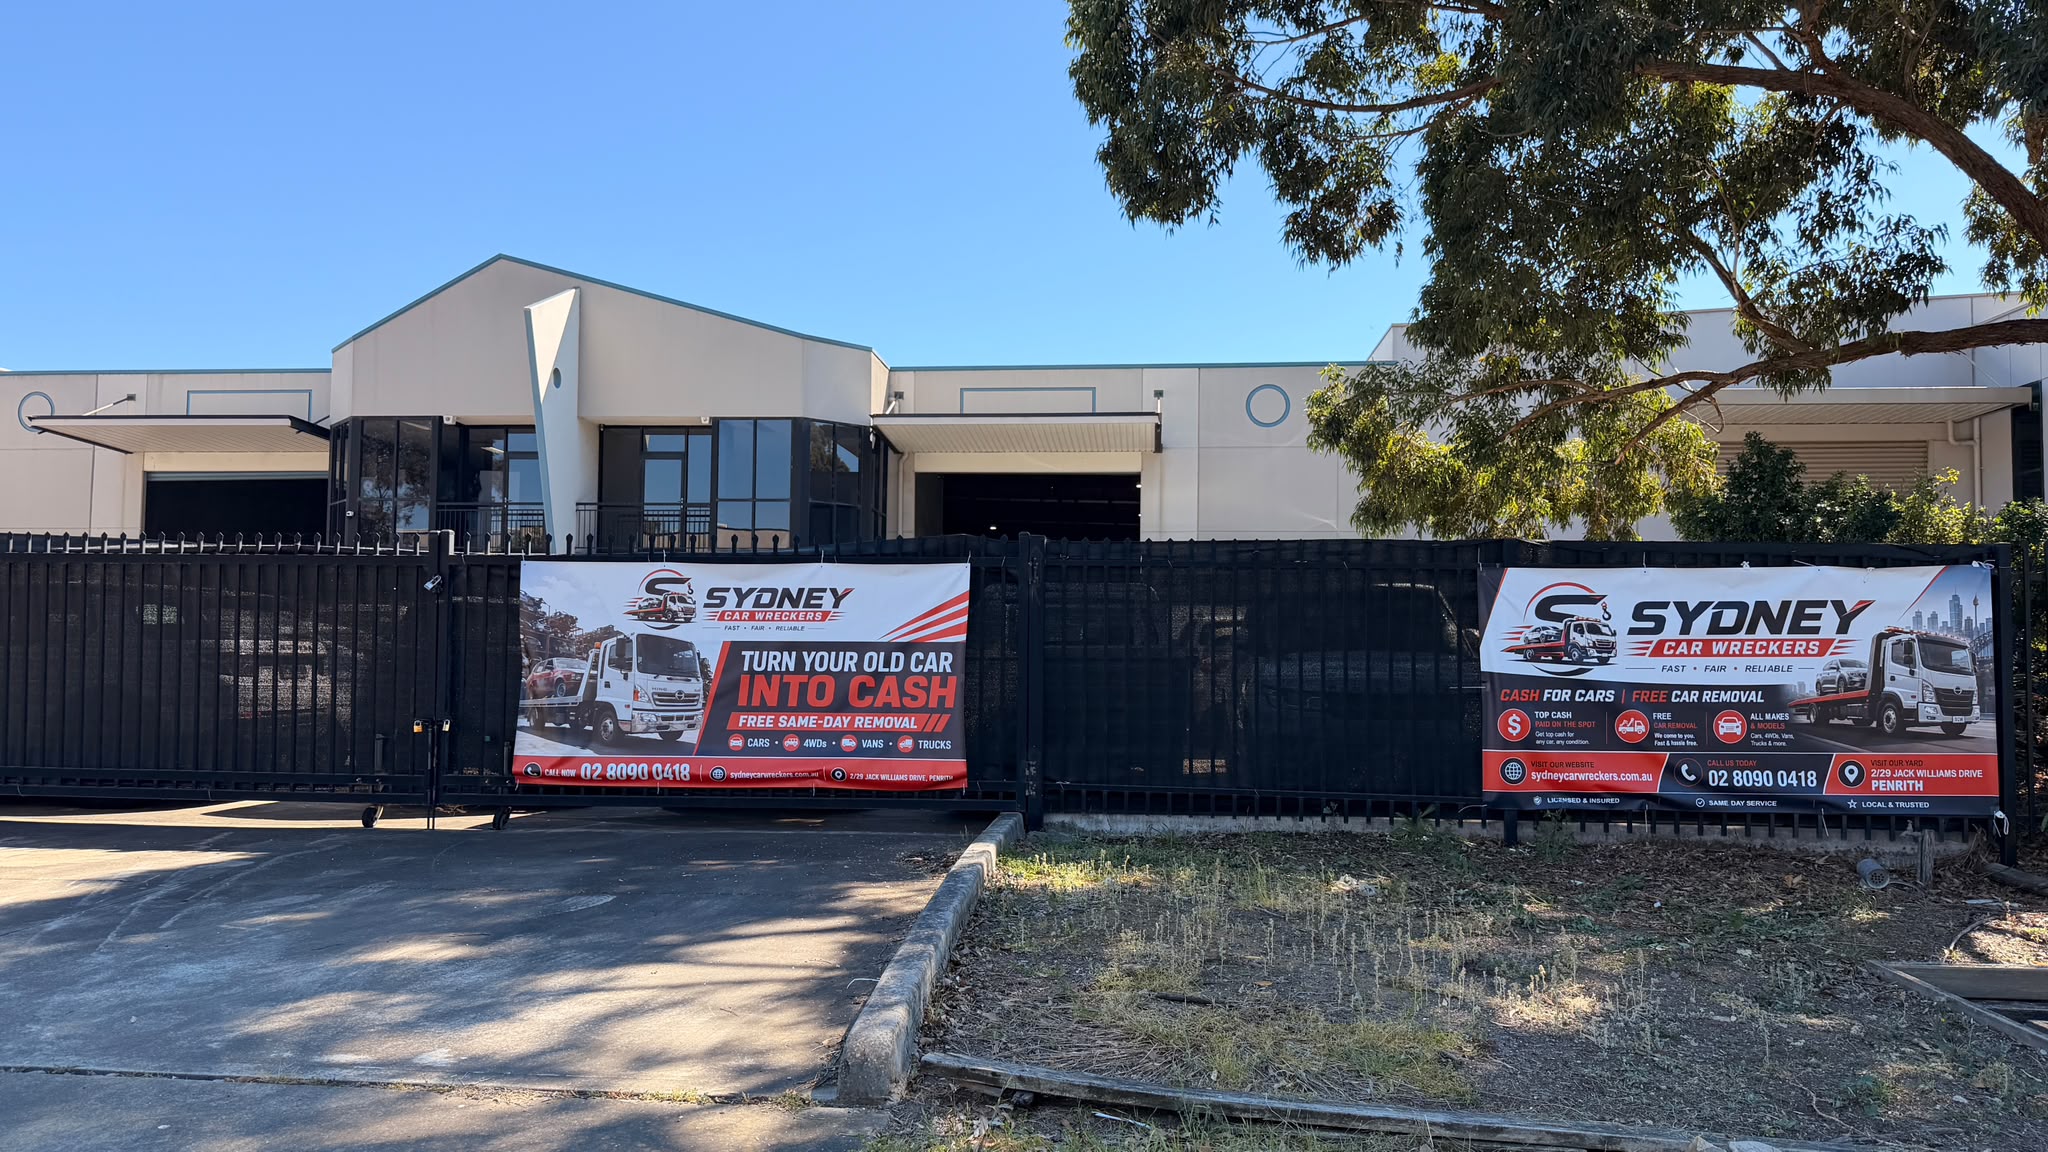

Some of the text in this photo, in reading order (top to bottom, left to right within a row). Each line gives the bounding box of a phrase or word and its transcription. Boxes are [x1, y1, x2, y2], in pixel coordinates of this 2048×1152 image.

[703, 588, 855, 609] SYDNEY
[724, 612, 822, 620] CAR WRECKERS
[1627, 600, 1877, 635] SYDNEY
[1663, 641, 1820, 655] CAR WRECKERS
[741, 651, 952, 673] TURN YOUR OLD CAR
[738, 675, 957, 709] INTO CASH
[1501, 689, 1615, 702] CASH FOR CARS
[1632, 691, 1764, 703] FREE CAR REMOVAL
[739, 715, 917, 729] FREE SAME-DAY REMOVAL
[747, 738, 951, 749] CARS 4WDs VANS TRUCKS
[561, 769, 576, 777] NOW
[581, 763, 691, 781] 02 8090 0418
[730, 771, 818, 779] sydneycarwreckers.com.au
[909, 774, 927, 782] DRIVE,
[1531, 771, 1652, 782] sydneycarwreckers.com.au
[1871, 769, 1983, 778] 2/29 JACK WILLIAMS DRIVE
[1708, 770, 1817, 787] 02 8090 0418
[1871, 780, 1924, 791] PENRITH
